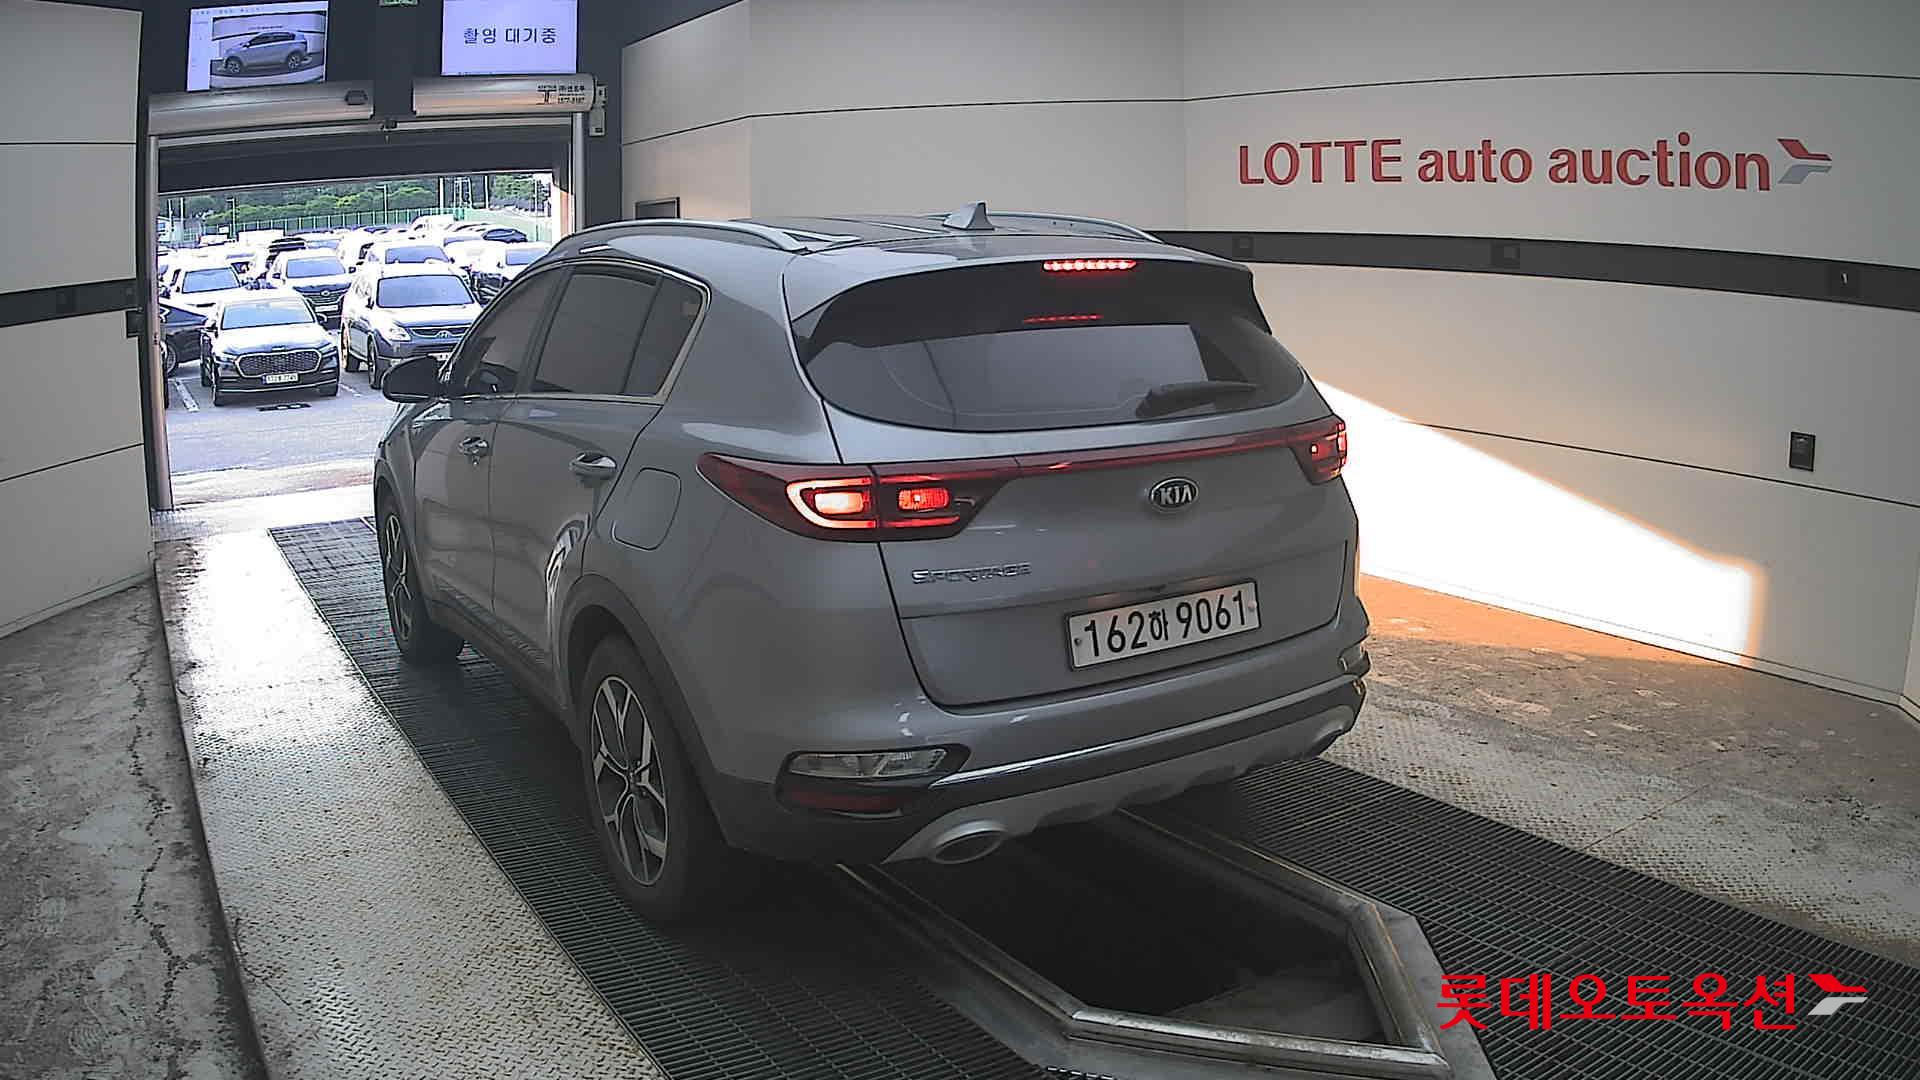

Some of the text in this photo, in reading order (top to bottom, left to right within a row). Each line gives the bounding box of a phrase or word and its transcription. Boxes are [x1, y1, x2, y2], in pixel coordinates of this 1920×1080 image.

[463, 27, 557, 45] 촬영 대기중
[1239, 132, 1771, 191] LOTTE auto auction
[1159, 484, 1192, 505] KIA
